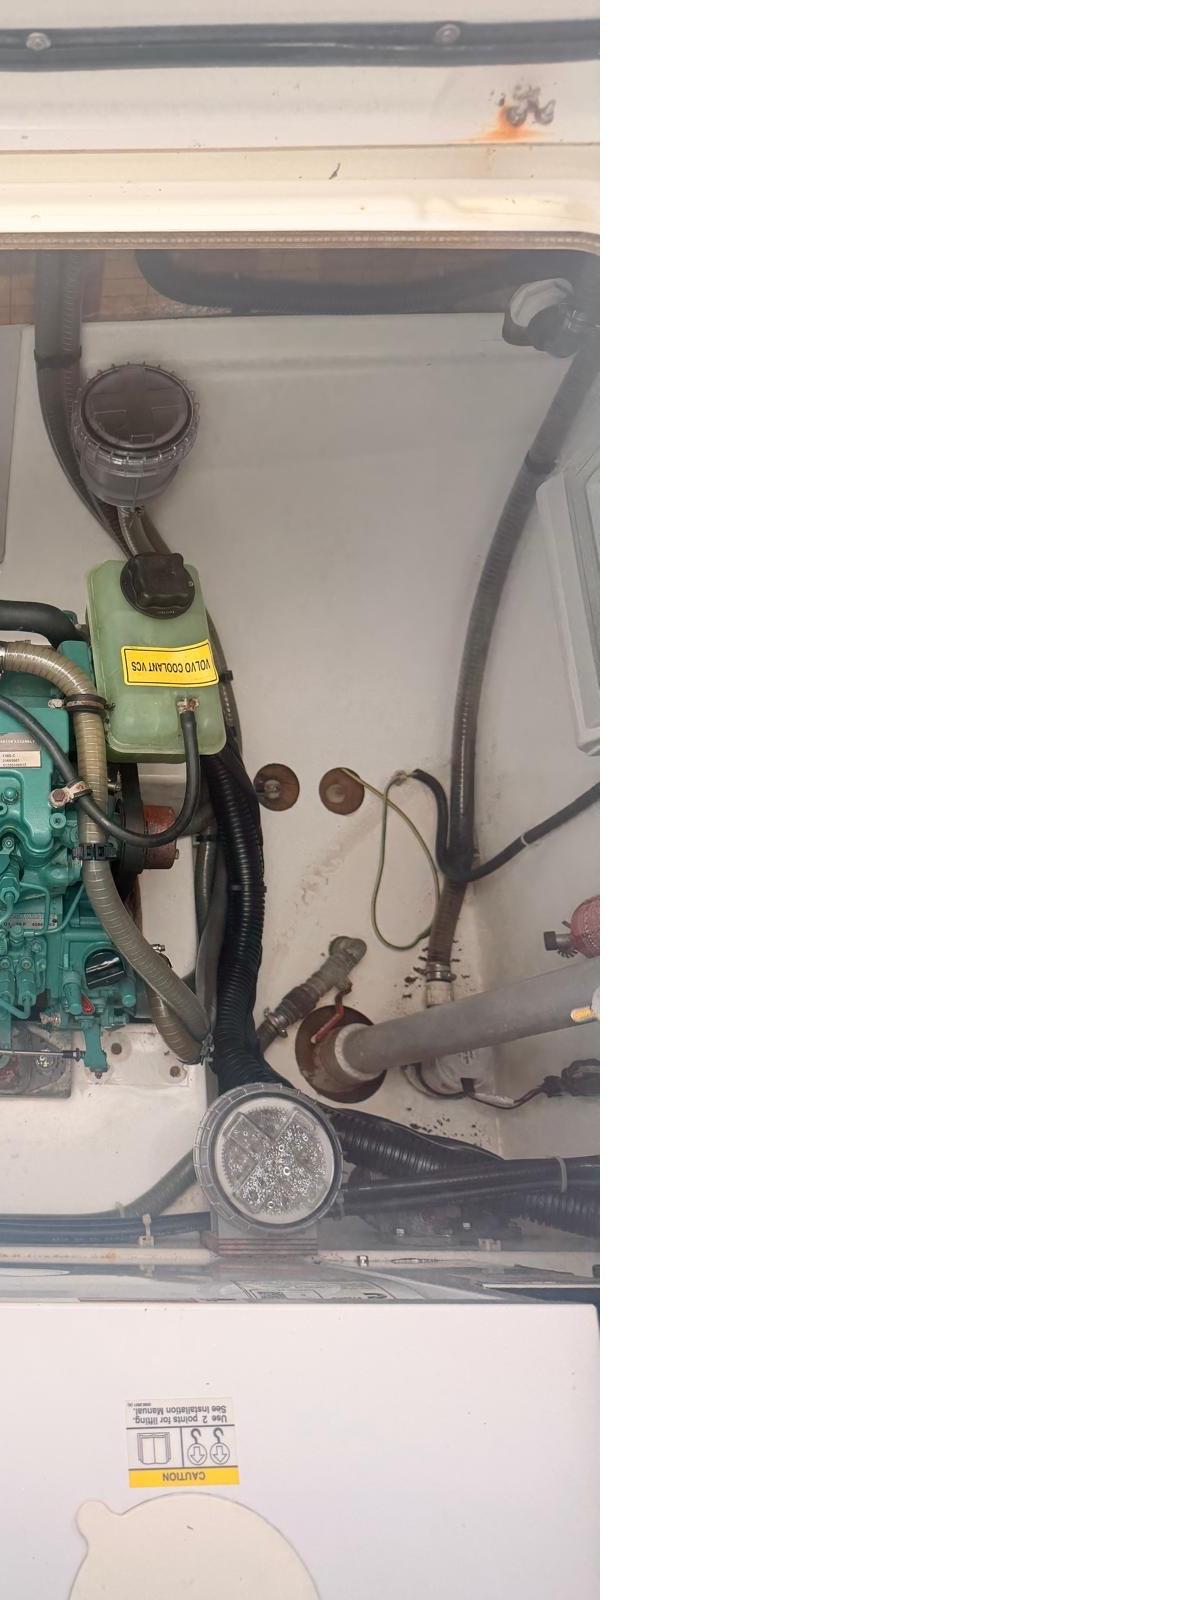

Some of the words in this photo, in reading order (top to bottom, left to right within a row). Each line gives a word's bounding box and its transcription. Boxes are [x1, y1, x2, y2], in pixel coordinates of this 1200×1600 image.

[131, 661, 147, 671] VCS
[149, 661, 183, 673] COOLANT
[185, 659, 211, 673] VOLVO
[166, 1405, 210, 1414] Installation
[211, 1405, 227, 1414] See
[132, 1416, 158, 1425] lifting.
[159, 1416, 171, 1424] for
[172, 1414, 198, 1424] points
[202, 1415, 208, 1424] 2
[211, 1415, 228, 1423] Use
[162, 1471, 206, 1481] CAUTION
